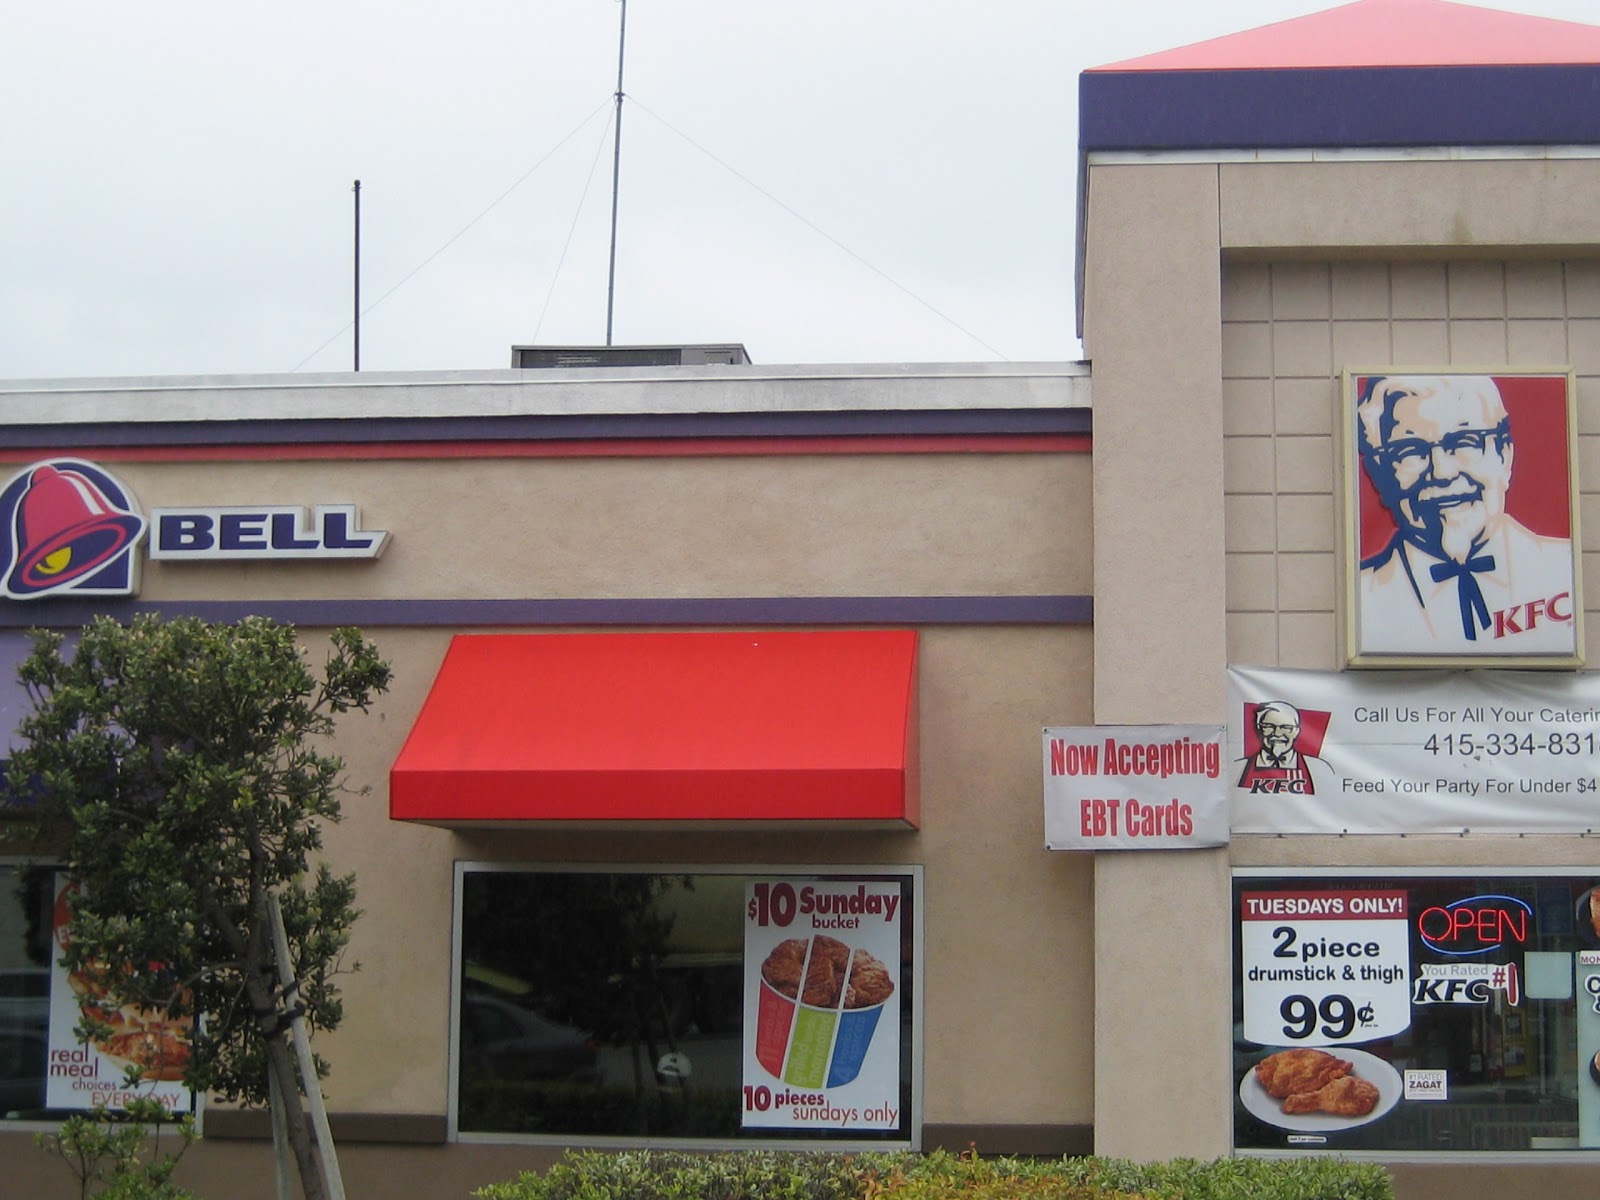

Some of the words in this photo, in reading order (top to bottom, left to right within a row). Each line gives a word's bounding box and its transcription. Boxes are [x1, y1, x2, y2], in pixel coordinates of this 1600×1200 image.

[159, 513, 374, 551] BELL
[1493, 592, 1572, 639] KFC
[1354, 707, 1389, 723] Call
[1395, 707, 1420, 723] Us
[1426, 707, 1457, 723] For
[1462, 707, 1485, 723] All
[1490, 707, 1534, 723] Your
[1423, 732, 1600, 756] 415-334-831
[1050, 738, 1099, 776] Now
[1104, 737, 1220, 779] Accepting
[1250, 778, 1307, 795] KFC
[1343, 778, 1385, 793] Feed
[1390, 779, 1430, 793] Your
[1436, 779, 1480, 797] Party
[1486, 779, 1515, 793] For
[1520, 779, 1572, 793] Under
[1577, 777, 1597, 794] $4
[1080, 799, 1120, 837] EBT
[1125, 798, 1193, 837] Cards
[748, 882, 797, 928] $10
[800, 885, 900, 922] Sunday
[1247, 898, 1344, 915] TUESDAYS
[1349, 897, 1403, 914] ONLY!
[812, 914, 860, 930] bucket
[1418, 906, 1527, 942] OPEN
[1272, 926, 1298, 959] 2
[1302, 937, 1381, 962] piece
[1248, 965, 1336, 982] drumstick
[1342, 965, 1356, 981] &
[1360, 964, 1404, 985] thigh
[1423, 965, 1447, 976] You
[1450, 964, 1489, 976] Rated
[1414, 978, 1489, 1002] KFC
[50, 1040, 89, 1062] real
[49, 1057, 99, 1077] meal
[72, 1077, 117, 1091] choices
[1409, 1081, 1442, 1089] ZAGAT
[743, 1085, 771, 1112] 10
[775, 1088, 825, 1109] pieces
[792, 1101, 859, 1126] sundays
[864, 1101, 898, 1127] only
